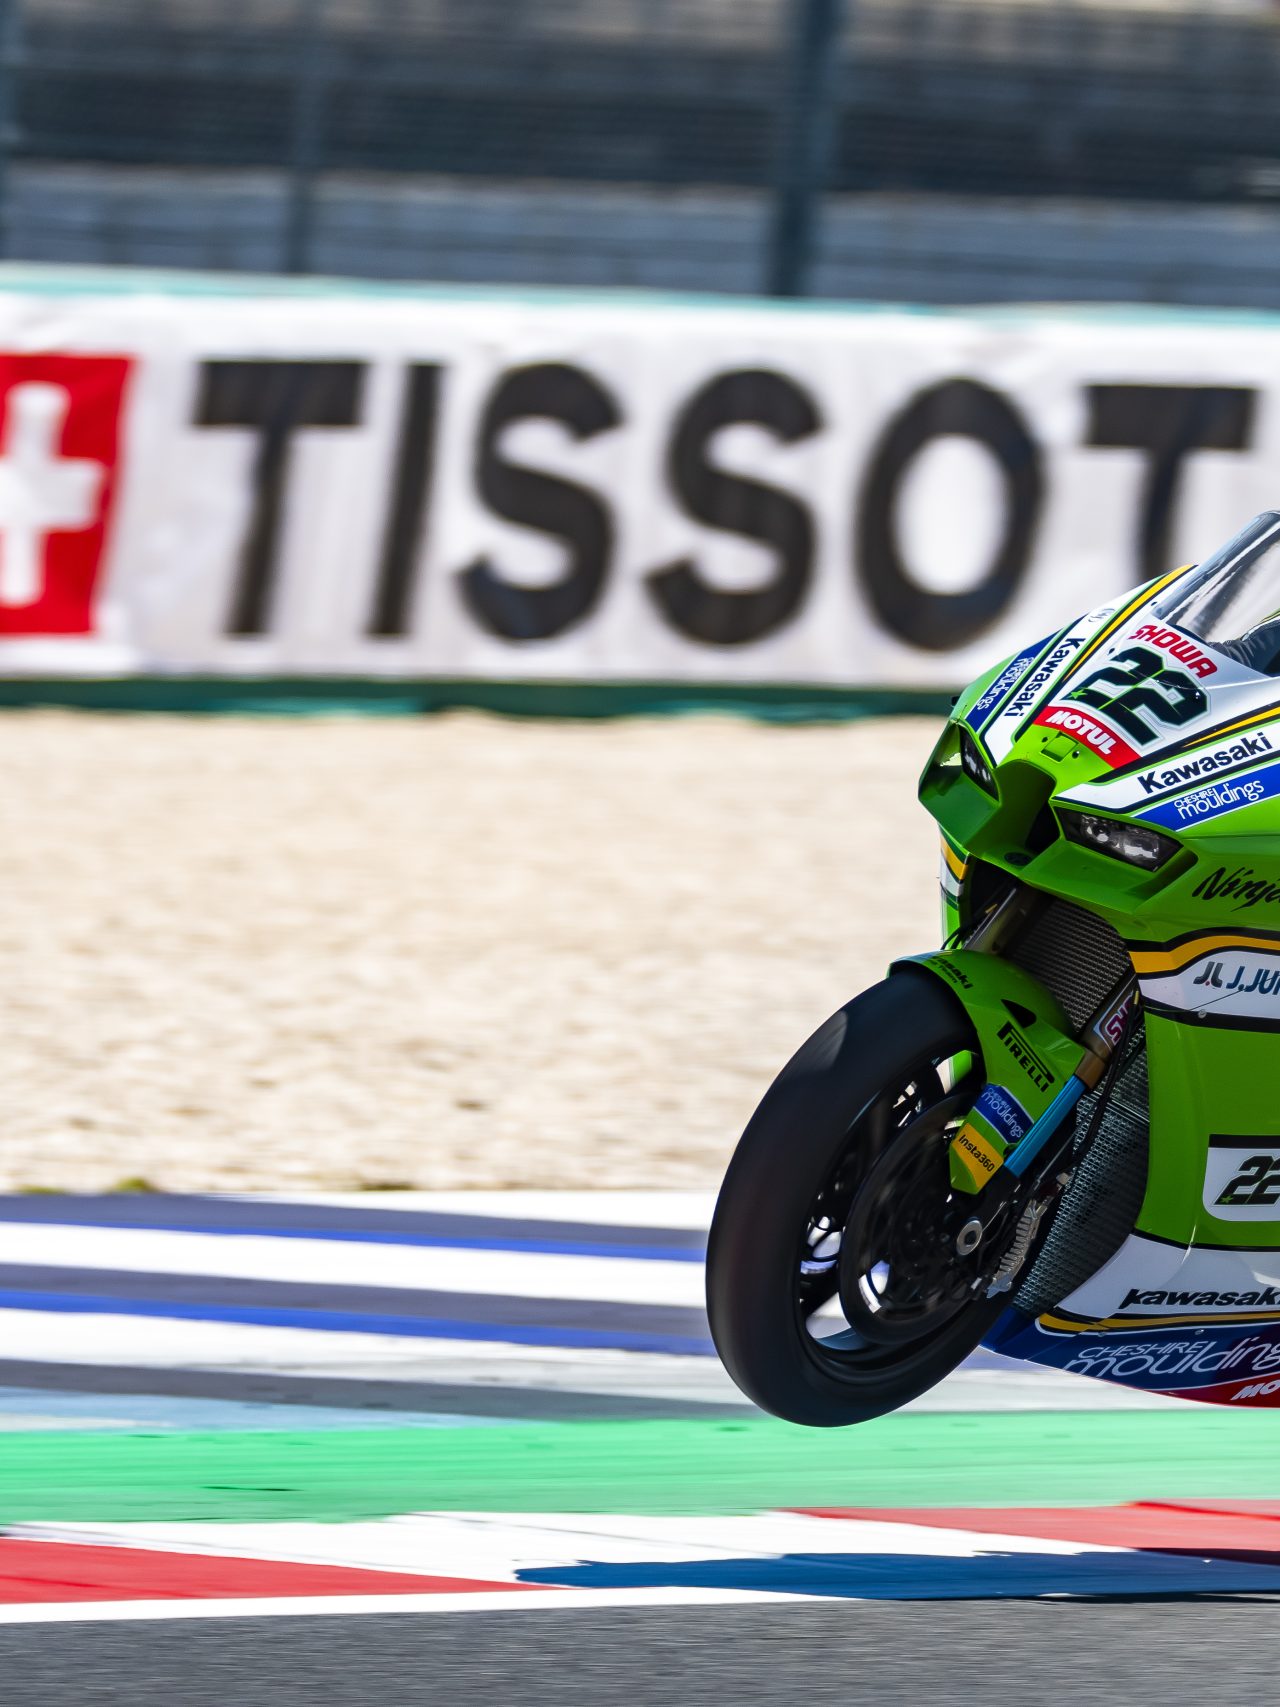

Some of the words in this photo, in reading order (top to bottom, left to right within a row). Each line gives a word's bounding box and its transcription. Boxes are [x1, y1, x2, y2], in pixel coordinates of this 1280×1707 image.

[193, 358, 1259, 651] TISSOT
[1004, 637, 1087, 717] Kawasaki
[1127, 624, 1218, 679] SHOWA
[1062, 646, 1209, 747] 22
[1046, 711, 1116, 755] MOTUL
[1137, 732, 1273, 794] Kawasaki
[1178, 780, 1264, 820] mouldings
[997, 1021, 1055, 1092] PIRELLI
[981, 1091, 1024, 1138] mouldings
[958, 1133, 995, 1173] Insta360
[1078, 1339, 1204, 1360] CHESHIRE
